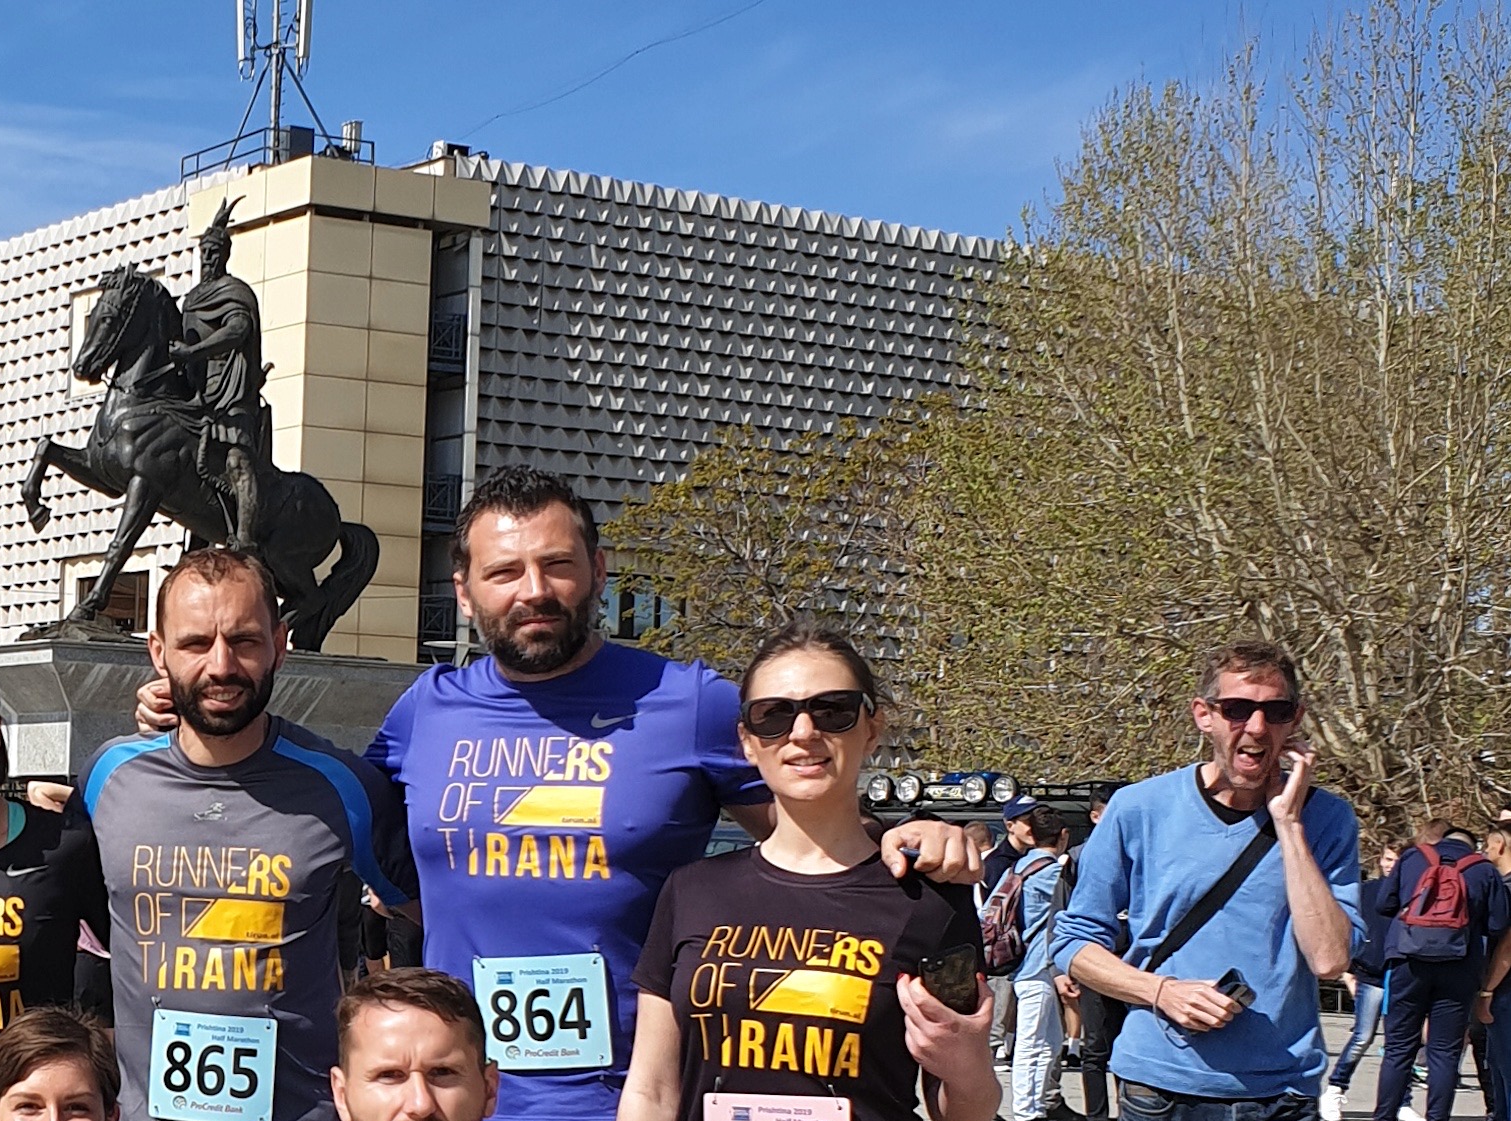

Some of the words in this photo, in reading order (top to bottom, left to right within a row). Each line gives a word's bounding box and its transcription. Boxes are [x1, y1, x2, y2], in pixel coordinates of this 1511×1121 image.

[448, 736, 614, 782] RUNNERS
[439, 782, 488, 822] OF
[133, 845, 292, 897] RUNNERS
[437, 828, 611, 879] TIRANA
[134, 892, 173, 936] OF
[138, 942, 284, 991] TIRANA
[701, 925, 884, 976] RUNNERS
[690, 962, 743, 1008] OF
[491, 987, 591, 1042] 864
[164, 1041, 258, 1099] 865
[524, 1049, 558, 1058] ProCredit
[561, 1048, 580, 1056] Bank
[690, 1013, 860, 1078] TIRANA
[190, 1101, 223, 1112] ProCredit
[224, 1105, 243, 1114] Bank
